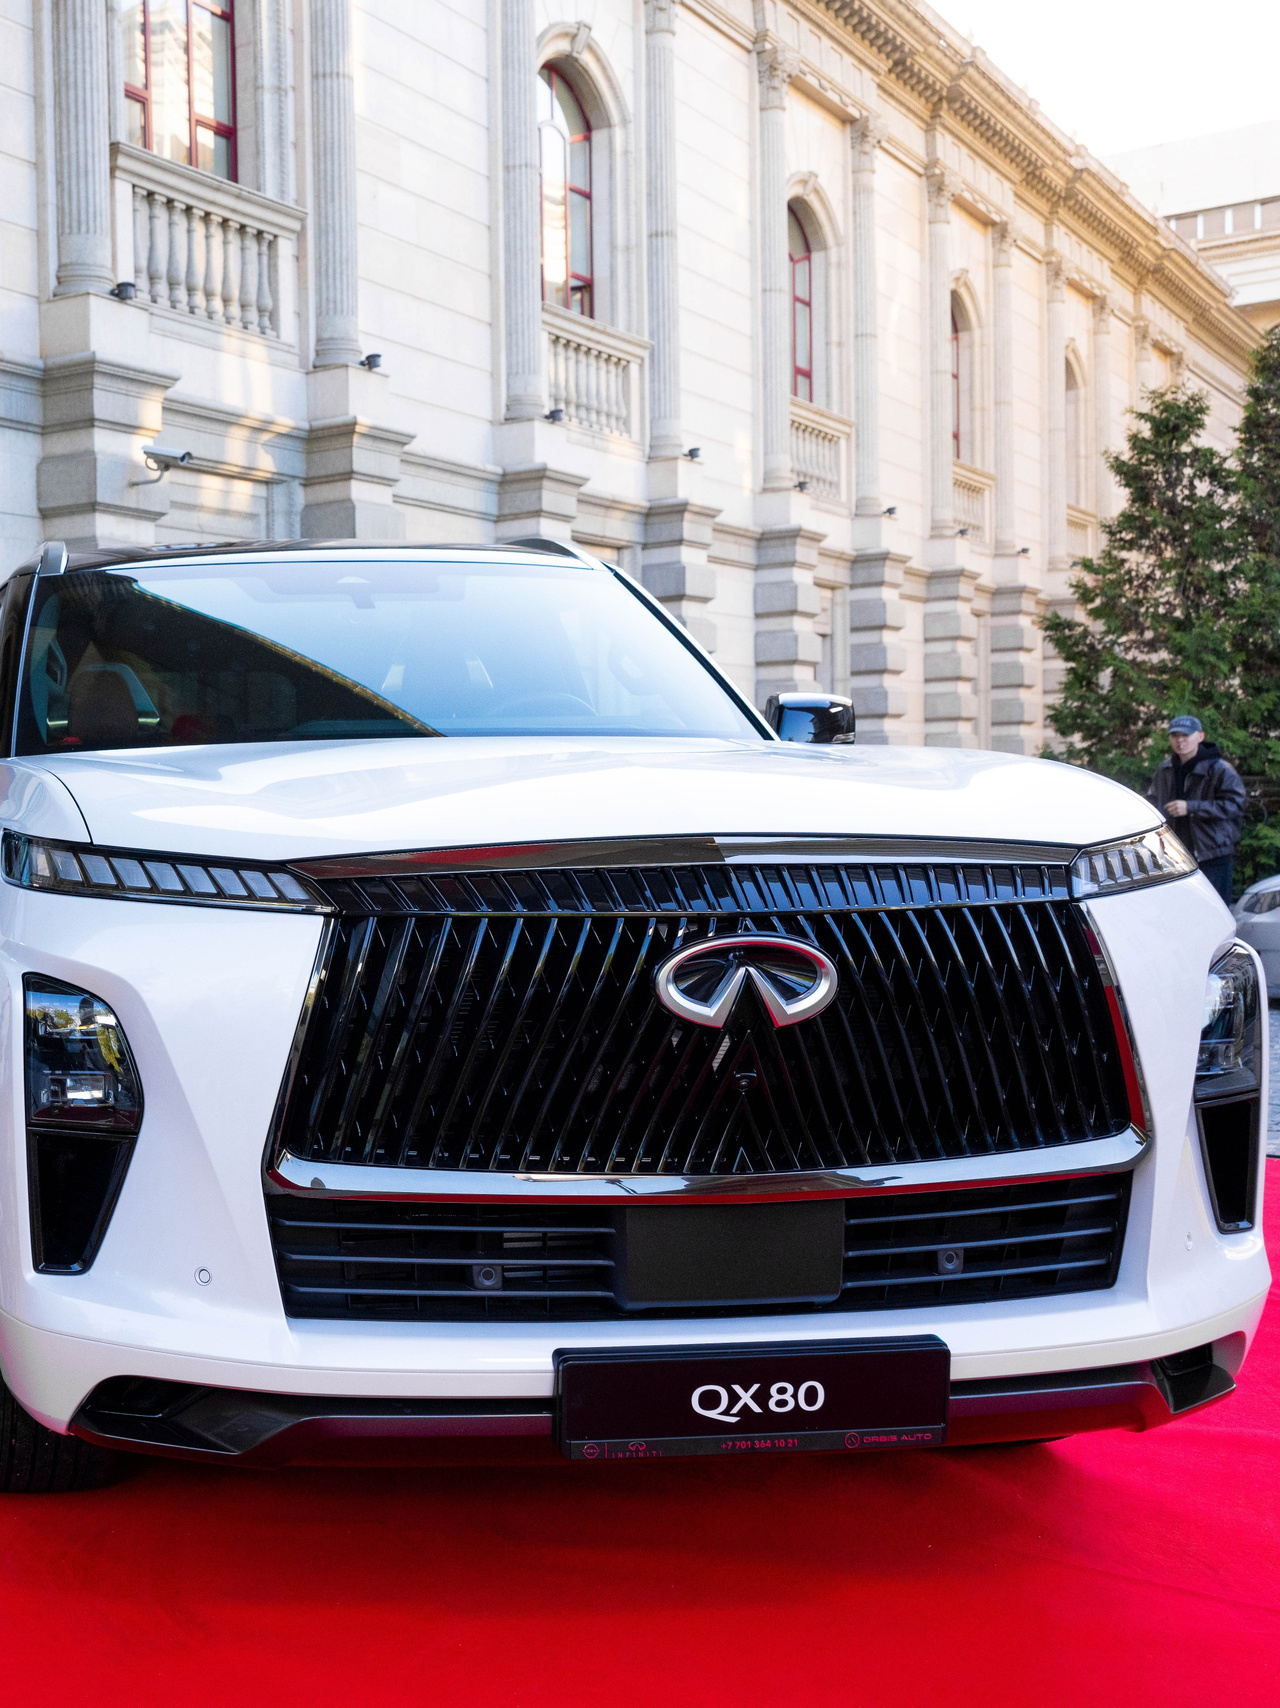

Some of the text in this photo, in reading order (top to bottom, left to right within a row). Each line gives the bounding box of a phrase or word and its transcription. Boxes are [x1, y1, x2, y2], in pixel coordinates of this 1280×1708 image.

[863, 1433, 933, 1443] ORBIS AUTO
[721, 1439, 799, 1449] +7 701 364 10 21
